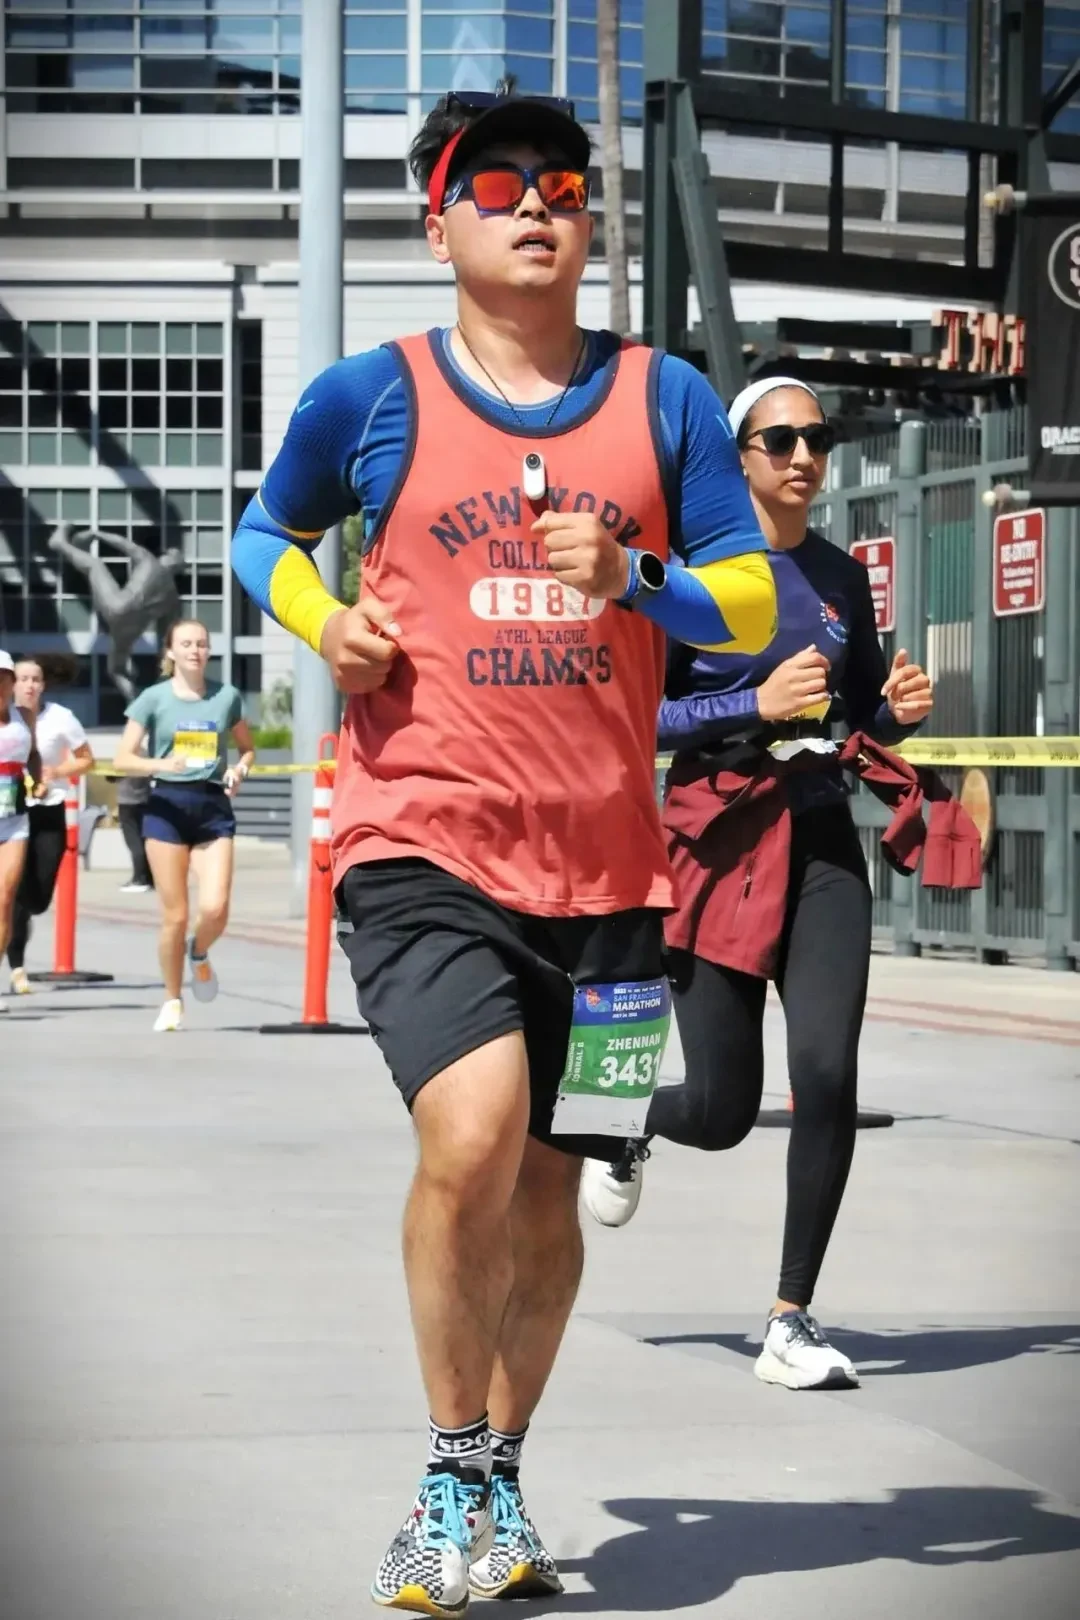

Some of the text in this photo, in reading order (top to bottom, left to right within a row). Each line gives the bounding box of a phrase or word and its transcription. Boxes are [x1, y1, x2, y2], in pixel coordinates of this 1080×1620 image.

[1041, 426, 1080, 448] ORAC
[428, 486, 522, 558] NEW
[488, 539, 555, 570] COLL
[496, 628, 588, 644] ATHL LEAGUE
[466, 645, 612, 687] CHAMPS
[612, 997, 661, 1011] MARATHON
[606, 1032, 661, 1050] ZHENNAN
[438, 1431, 489, 1454] SPO
